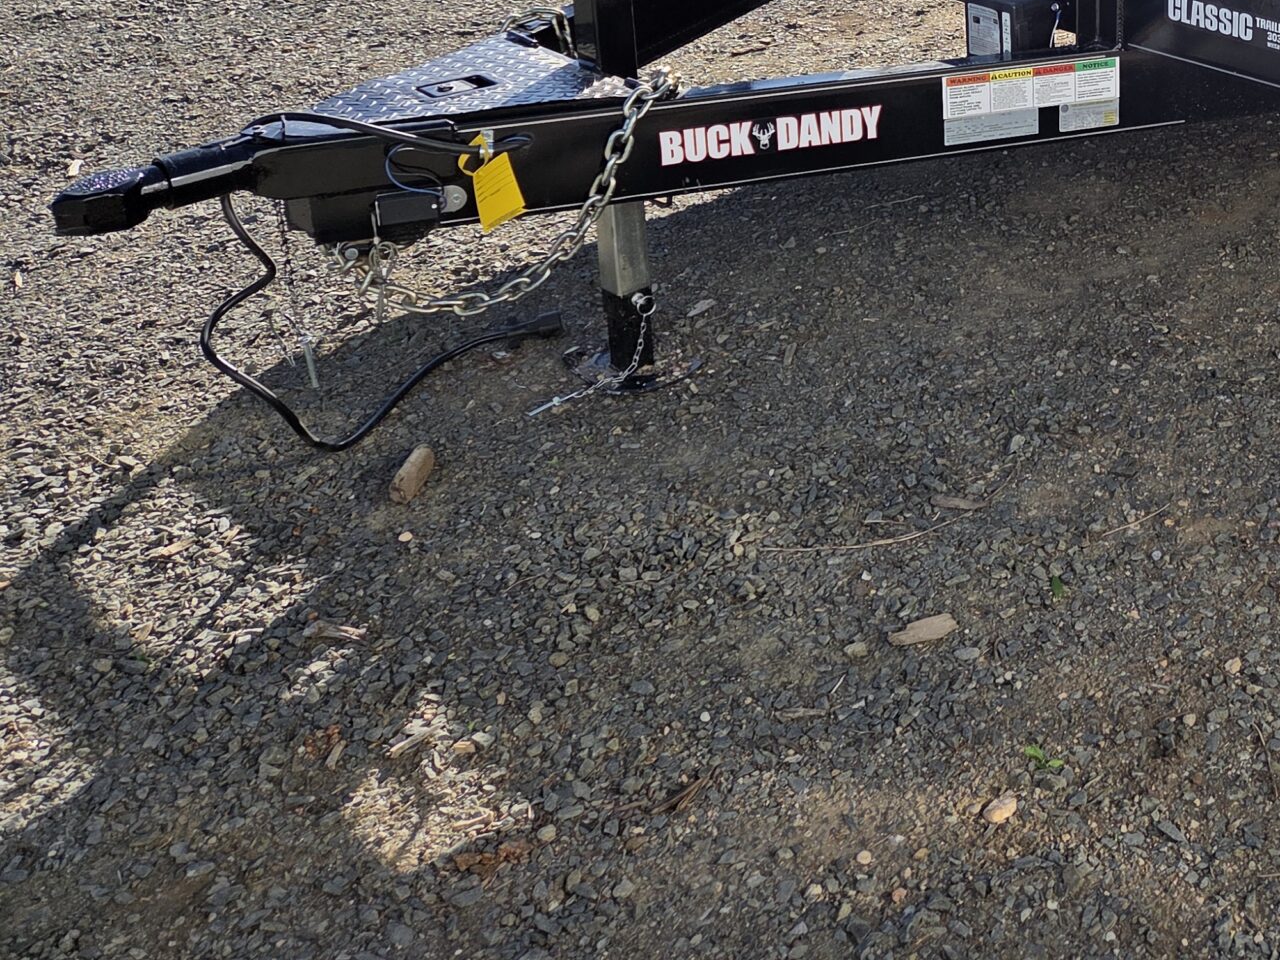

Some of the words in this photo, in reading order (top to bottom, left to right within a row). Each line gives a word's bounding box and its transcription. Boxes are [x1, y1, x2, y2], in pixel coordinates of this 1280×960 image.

[1042, 65, 1073, 74] DANGER
[1083, 61, 1109, 69] NOTICE
[998, 69, 1032, 79] CAUTION
[949, 75, 987, 85] WARNING
[659, 121, 755, 166] BUCK
[776, 104, 882, 151] DANDY
